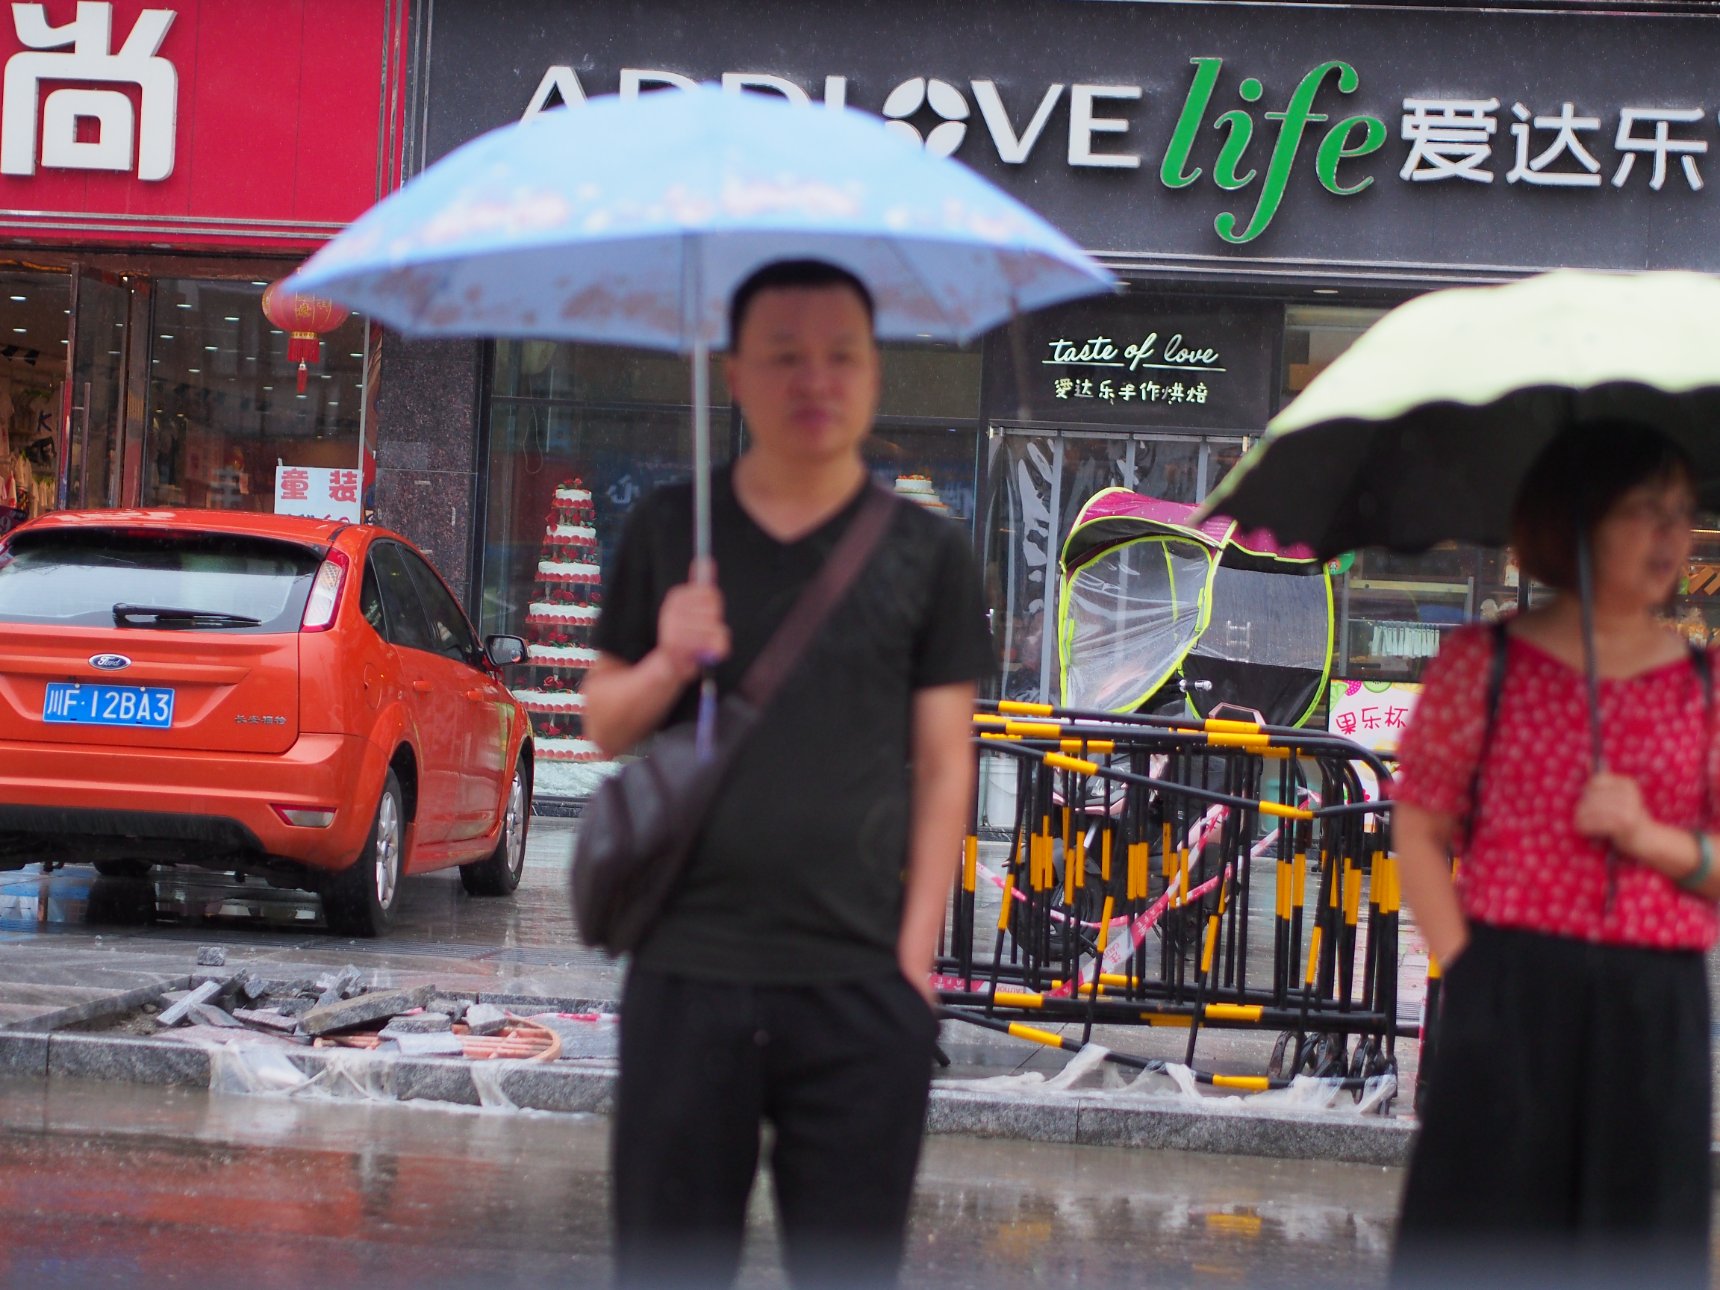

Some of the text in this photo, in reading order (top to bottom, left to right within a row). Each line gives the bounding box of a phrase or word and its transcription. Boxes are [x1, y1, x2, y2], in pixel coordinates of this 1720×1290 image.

[0, 0, 178, 181] 尚
[1159, 56, 1388, 243] life
[1398, 97, 1708, 191] 爱达乐
[1048, 332, 1219, 371] taste of love
[280, 468, 358, 503] 童装
[1335, 705, 1409, 735] 果乐杯
